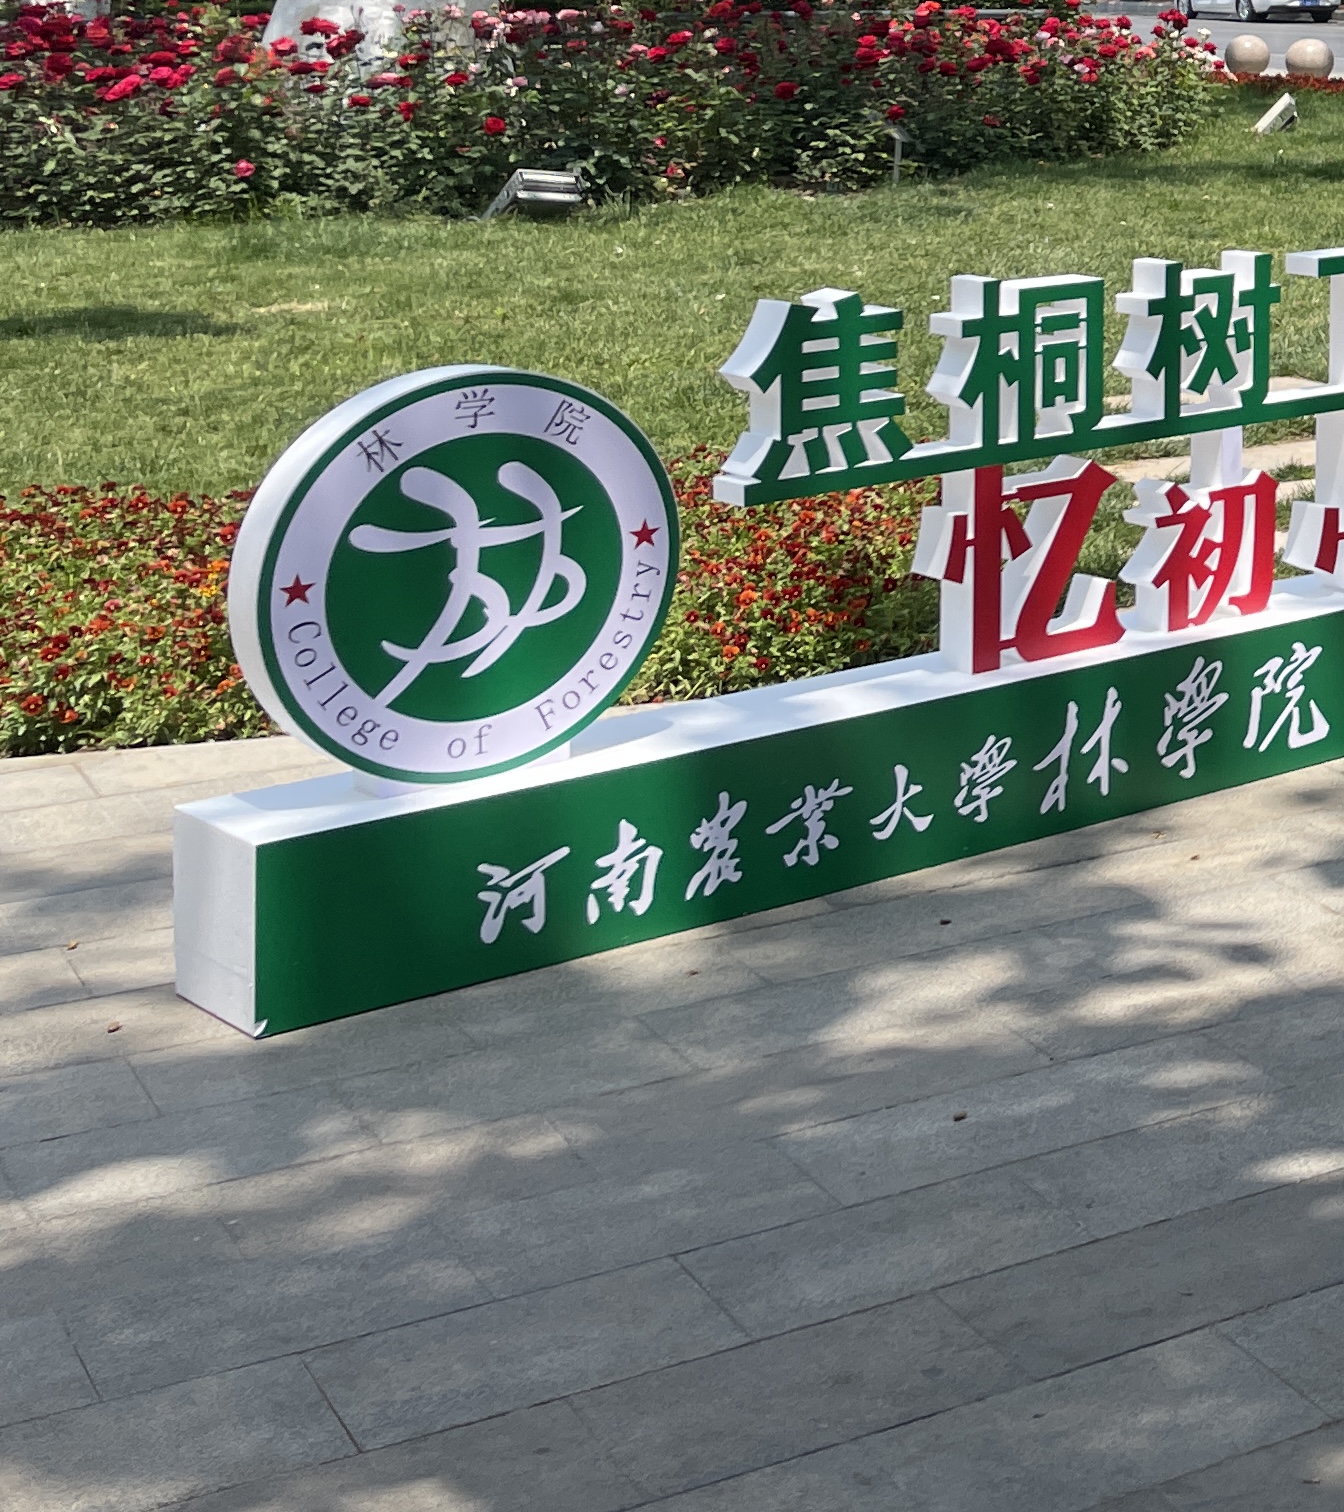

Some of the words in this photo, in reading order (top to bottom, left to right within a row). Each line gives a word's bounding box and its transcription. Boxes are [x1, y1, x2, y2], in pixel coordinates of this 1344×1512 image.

[356, 387, 592, 473] 林学院
[287, 620, 400, 752] College
[446, 723, 494, 760] of
[533, 560, 661, 732] Forestry
